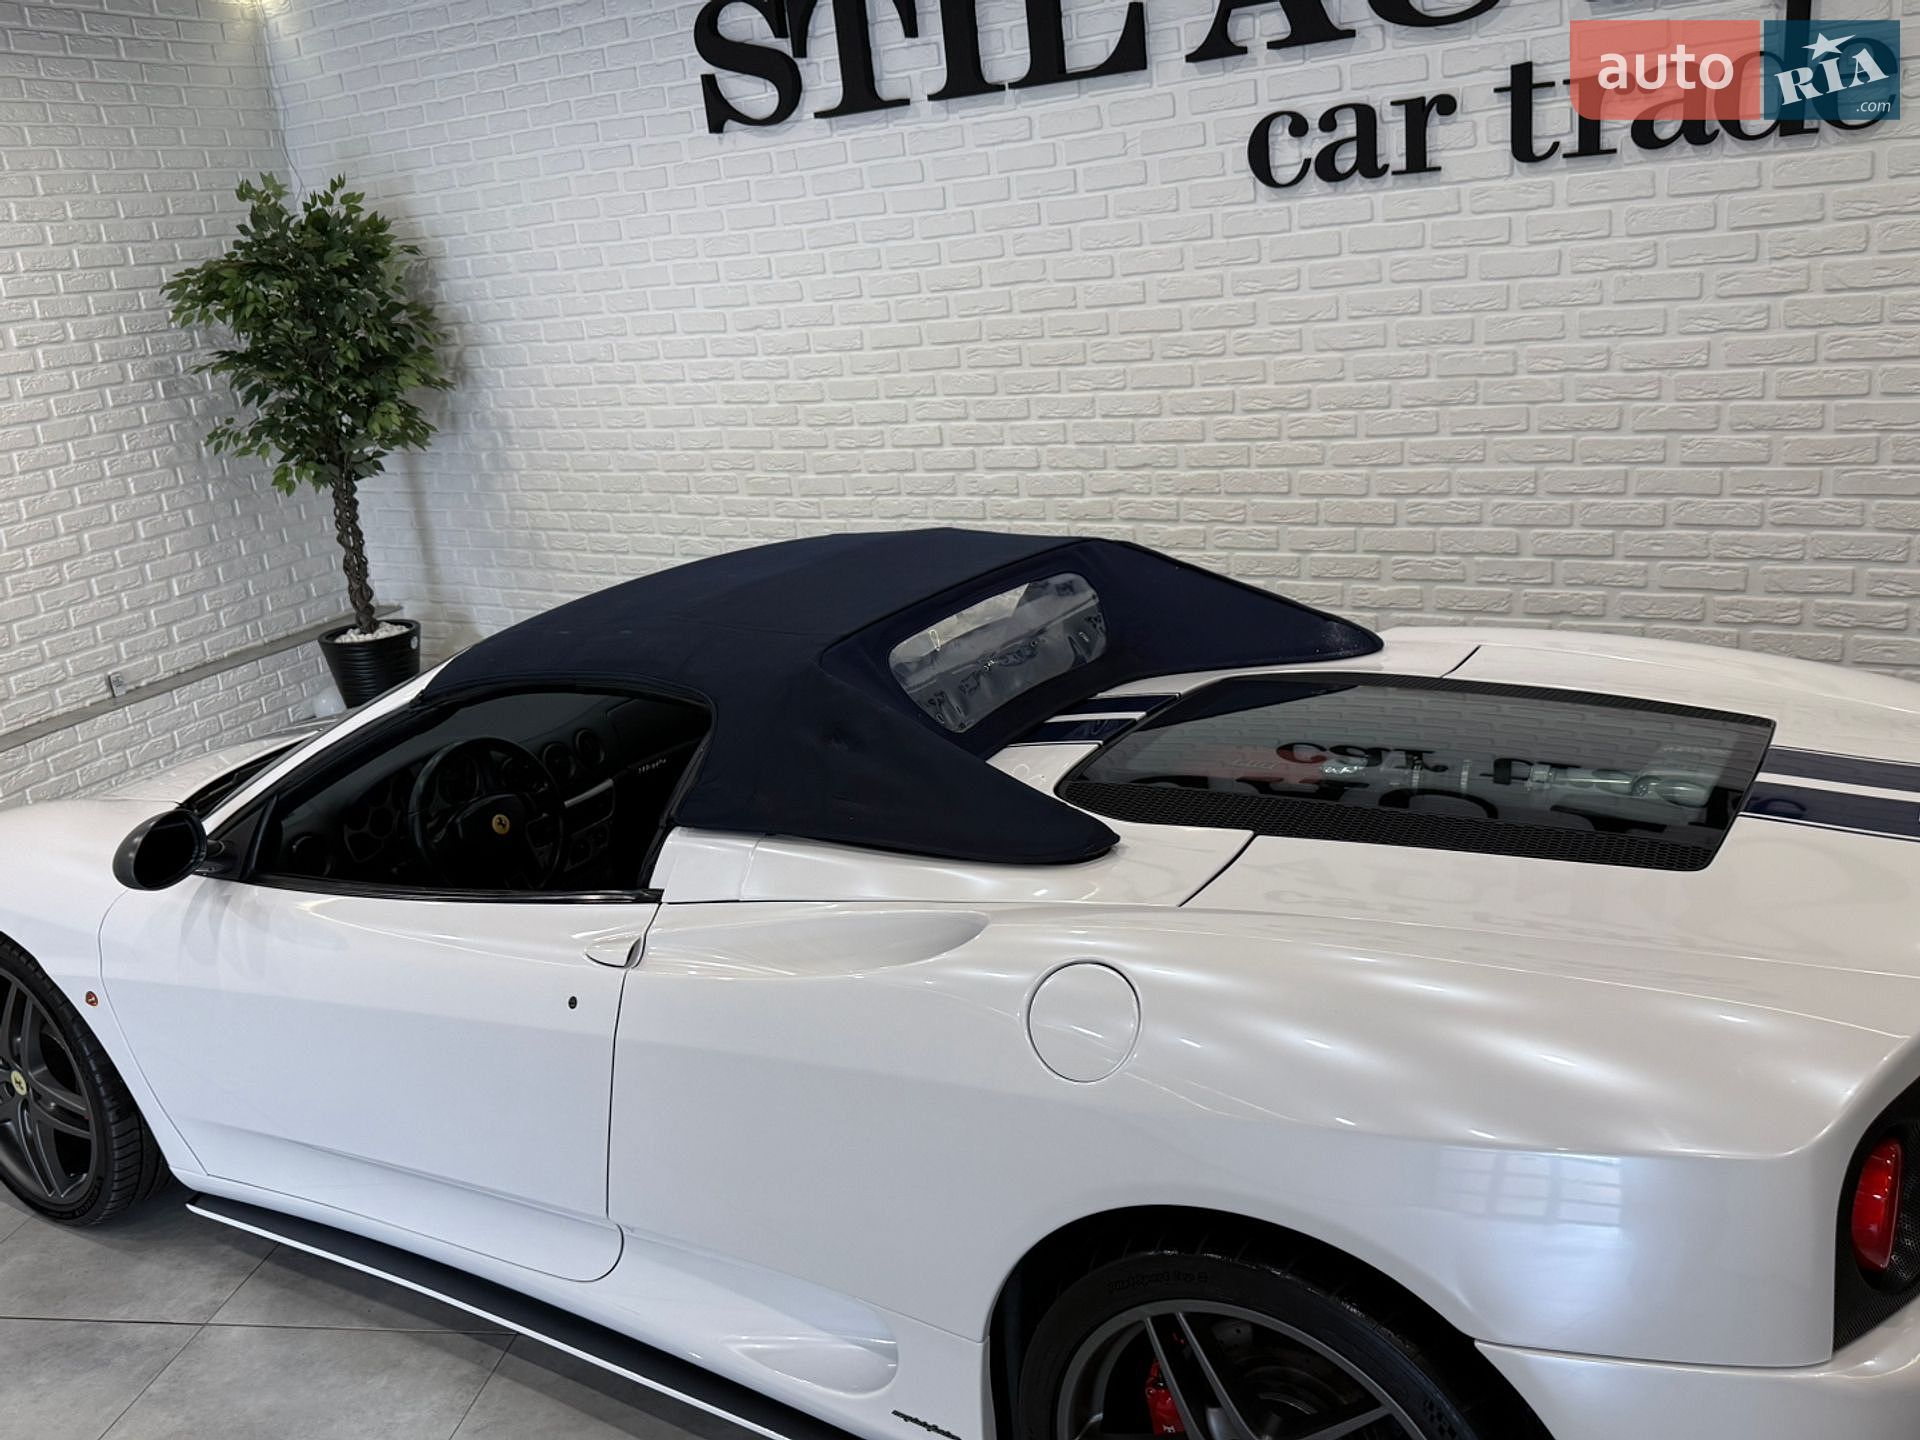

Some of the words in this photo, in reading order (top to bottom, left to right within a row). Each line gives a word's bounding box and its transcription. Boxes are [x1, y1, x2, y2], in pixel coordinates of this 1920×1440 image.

[693, 0, 1148, 134] STIL
[1247, 93, 1457, 188] car
[1494, 0, 1899, 163] trade
